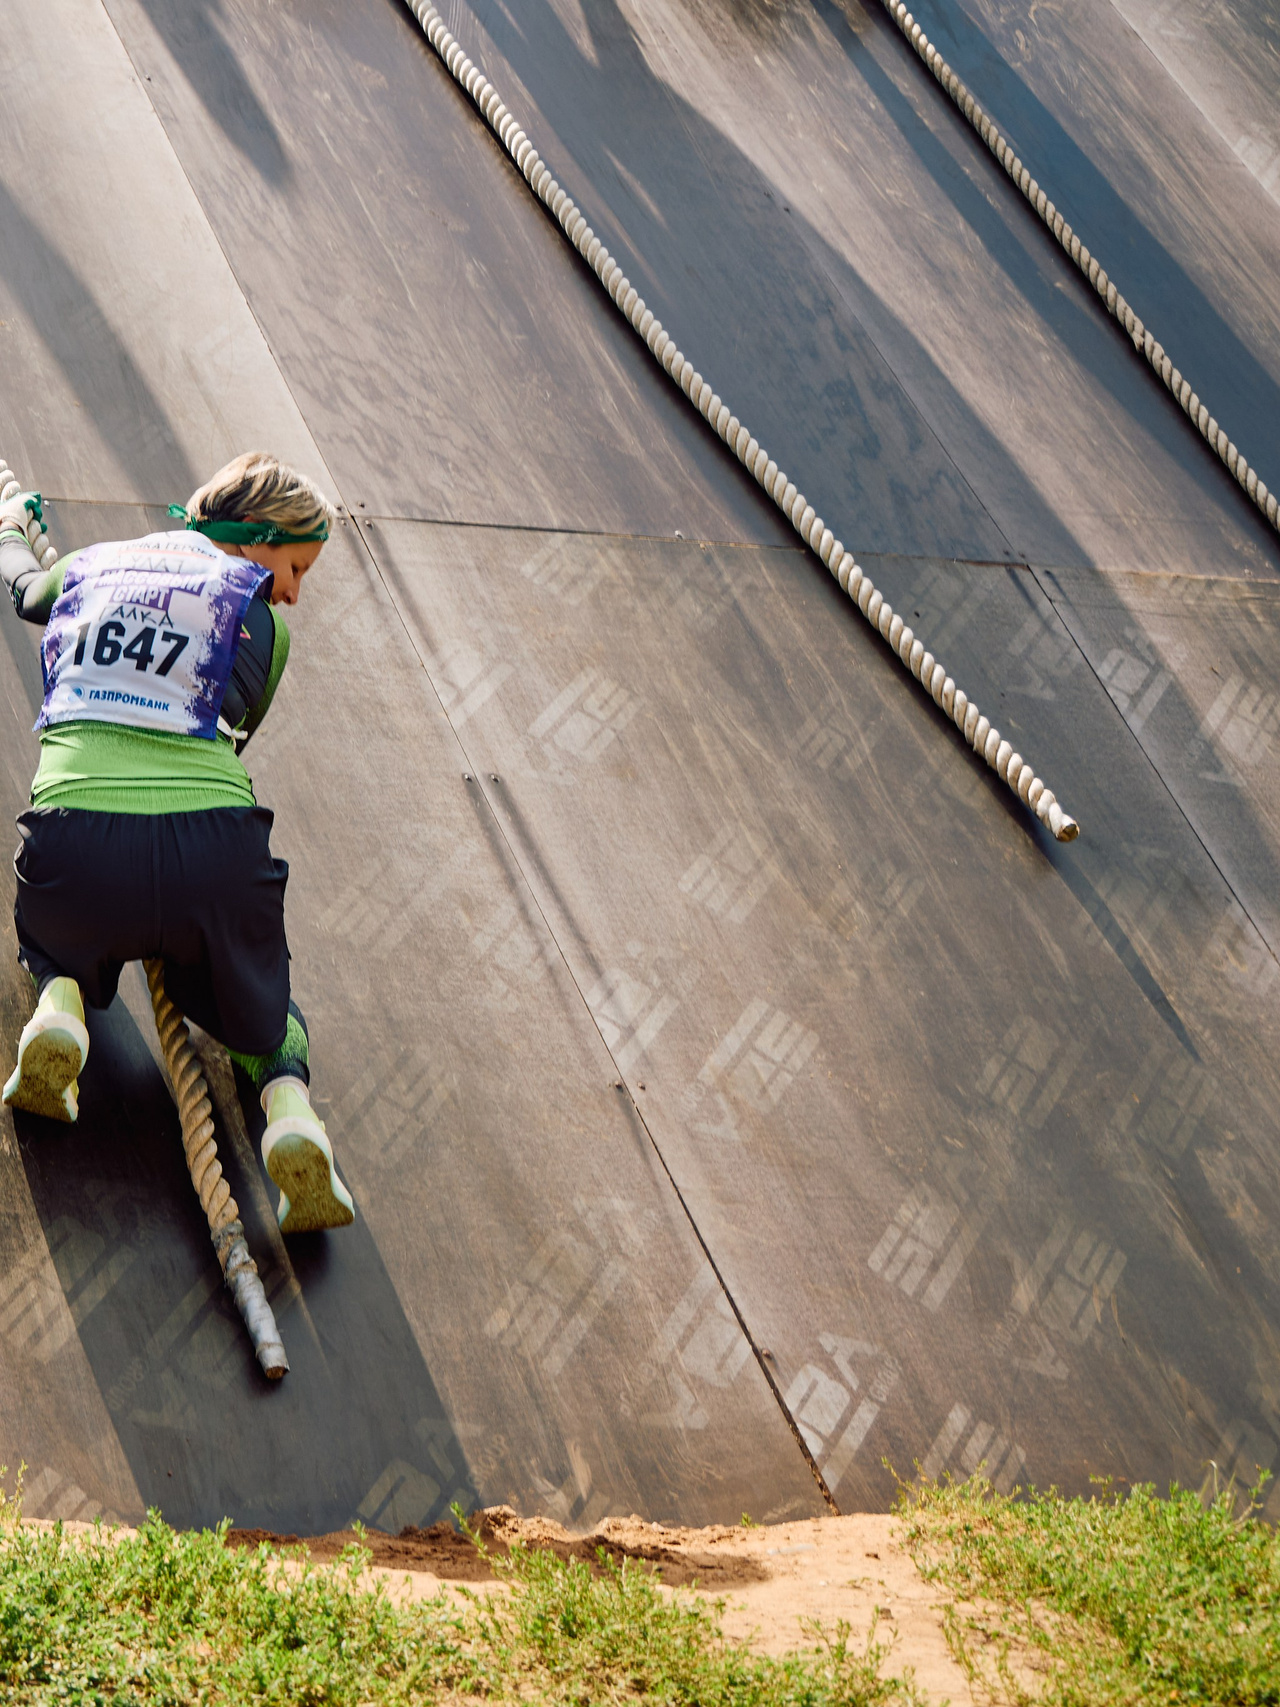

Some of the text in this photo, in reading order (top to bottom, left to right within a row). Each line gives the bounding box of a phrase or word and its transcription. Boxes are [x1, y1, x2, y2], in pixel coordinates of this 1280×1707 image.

[112, 585, 170, 609] СТАРТ
[73, 620, 190, 677] 1647
[88, 689, 170, 712] ГАЗПРОМБАНК
